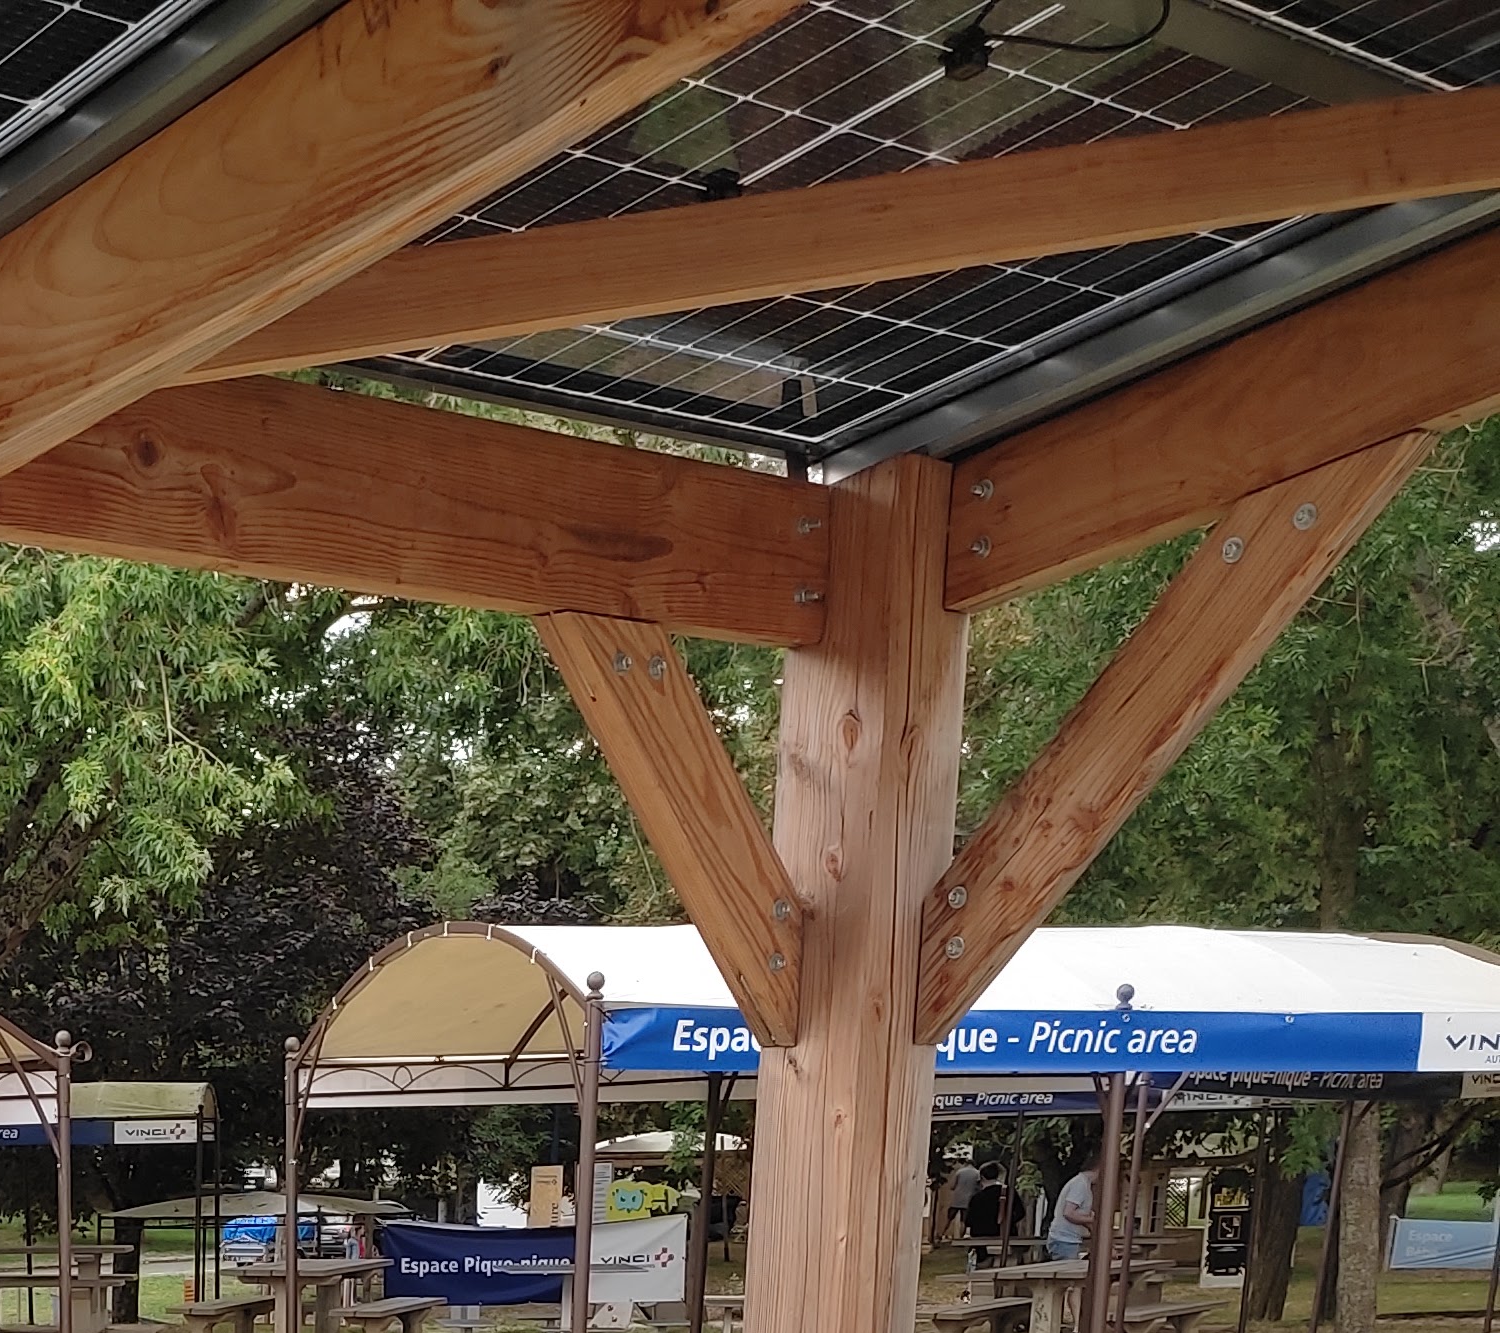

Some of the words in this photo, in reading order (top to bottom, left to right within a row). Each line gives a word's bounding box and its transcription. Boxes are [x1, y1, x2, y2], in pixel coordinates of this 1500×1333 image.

[1028, 1020, 1120, 1053] Picnic
[1127, 1029, 1197, 1054] area
[975, 1092, 1017, 1106] Picnic
[1019, 1093, 1054, 1105] area
[125, 1128, 167, 1136] VINCI
[600, 1254, 650, 1264] VINCI
[400, 1257, 459, 1278] Espace
